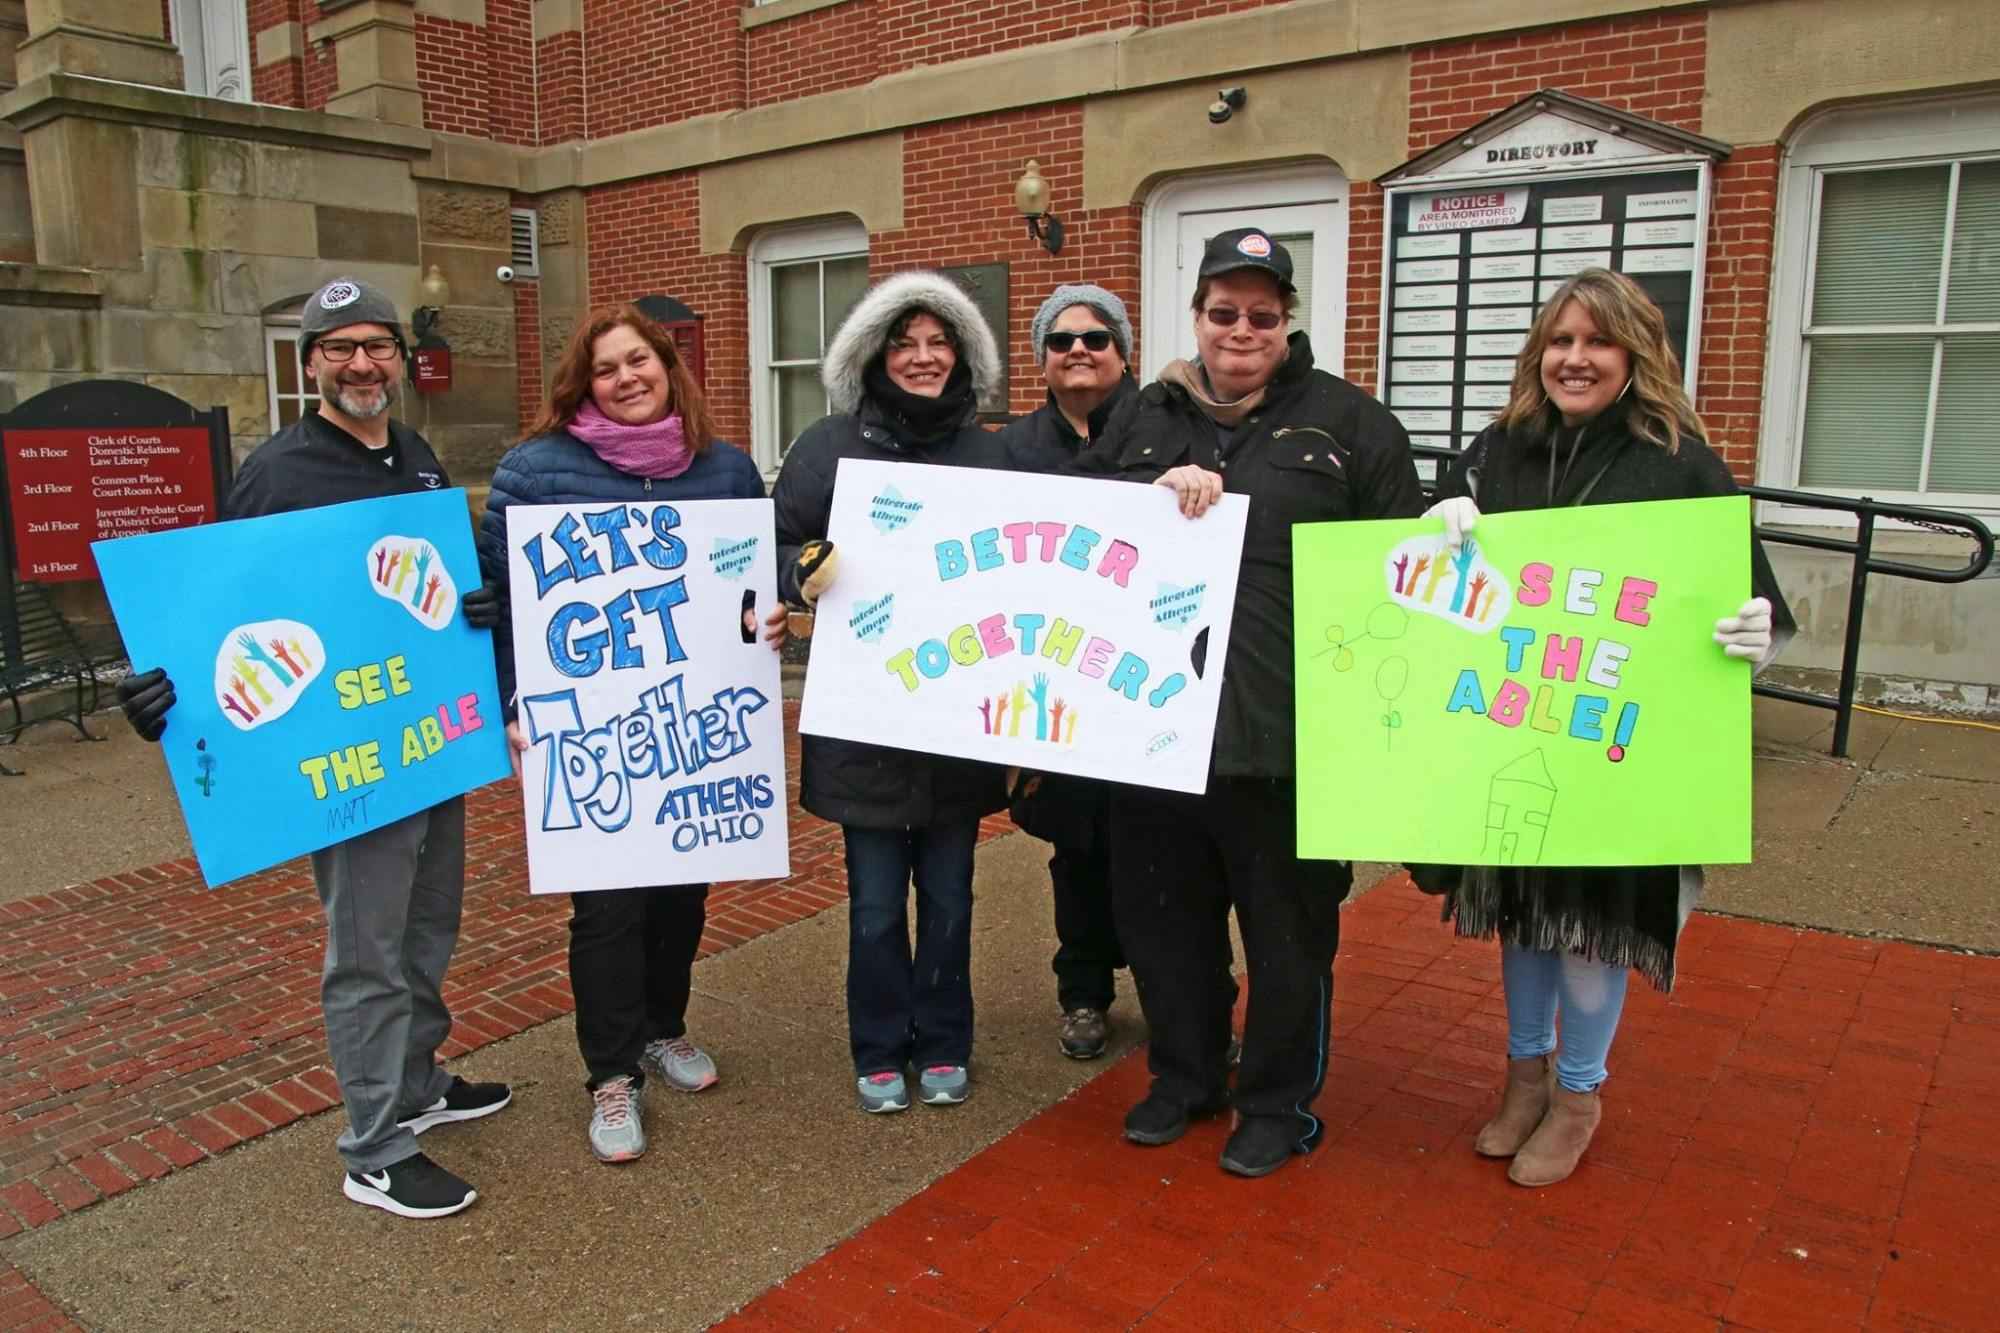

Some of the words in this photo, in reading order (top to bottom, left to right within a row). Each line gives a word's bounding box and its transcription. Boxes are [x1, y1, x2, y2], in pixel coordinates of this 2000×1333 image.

[1486, 139, 1598, 163] DIRECTORY
[1439, 194, 1497, 210] NOTICE
[1638, 197, 1688, 208] INFORMATION
[1418, 222, 1433, 232] BY
[1435, 219, 1468, 231] VIDEO
[1470, 216, 1517, 228] CAMERA
[1419, 211, 1449, 222] AREA
[1451, 207, 1517, 219] MONITORED
[88, 435, 116, 446] Clerk
[116, 435, 127, 445] of
[128, 434, 162, 445] Courts
[89, 446, 135, 457] Domestic
[136, 445, 181, 455] Relations
[19, 448, 38, 458] 4th
[39, 447, 69, 458] Floor
[90, 456, 112, 467] Law
[113, 456, 150, 468] Library
[23, 484, 43, 496] 3rd
[44, 484, 73, 495] Floor
[91, 475, 138, 486] Common
[139, 474, 165, 485] Pleas
[92, 487, 122, 498] Court
[123, 486, 155, 497] Room
[154, 486, 163, 496] A
[163, 485, 174, 495] &
[174, 485, 182, 494] B
[95, 506, 139, 520] Juvenile/
[140, 505, 177, 516] Probate
[177, 503, 205, 514] Court
[871, 493, 924, 514] Integrate
[27, 521, 50, 533] 2nd
[51, 520, 80, 532] Floor
[96, 518, 114, 529] 4th
[115, 516, 150, 528] District
[150, 515, 180, 526] Court
[868, 508, 909, 525] Athens
[98, 529, 109, 539] of
[522, 504, 688, 601] LET'S
[708, 536, 760, 562] Integrate
[934, 520, 1140, 589] BETTER
[32, 563, 48, 574] 1st
[49, 562, 79, 574] Floor
[713, 553, 753, 574] Athens
[1149, 580, 1208, 611] Integrate
[1516, 561, 1659, 627] SEE
[848, 591, 896, 630] Integrate
[1153, 600, 1199, 624] Athens
[546, 574, 690, 678] GET
[855, 610, 891, 642] Athens
[885, 613, 1188, 709] TOGETHER!
[1500, 625, 1632, 690] THE
[333, 654, 413, 711] SEE
[1445, 669, 1640, 763] ABLE!
[299, 740, 386, 801] THE
[400, 692, 484, 768] ABLE
[522, 673, 770, 834] Together
[655, 773, 776, 825] ATHENS
[326, 789, 377, 836] MATT
[671, 811, 765, 853] OHIO
